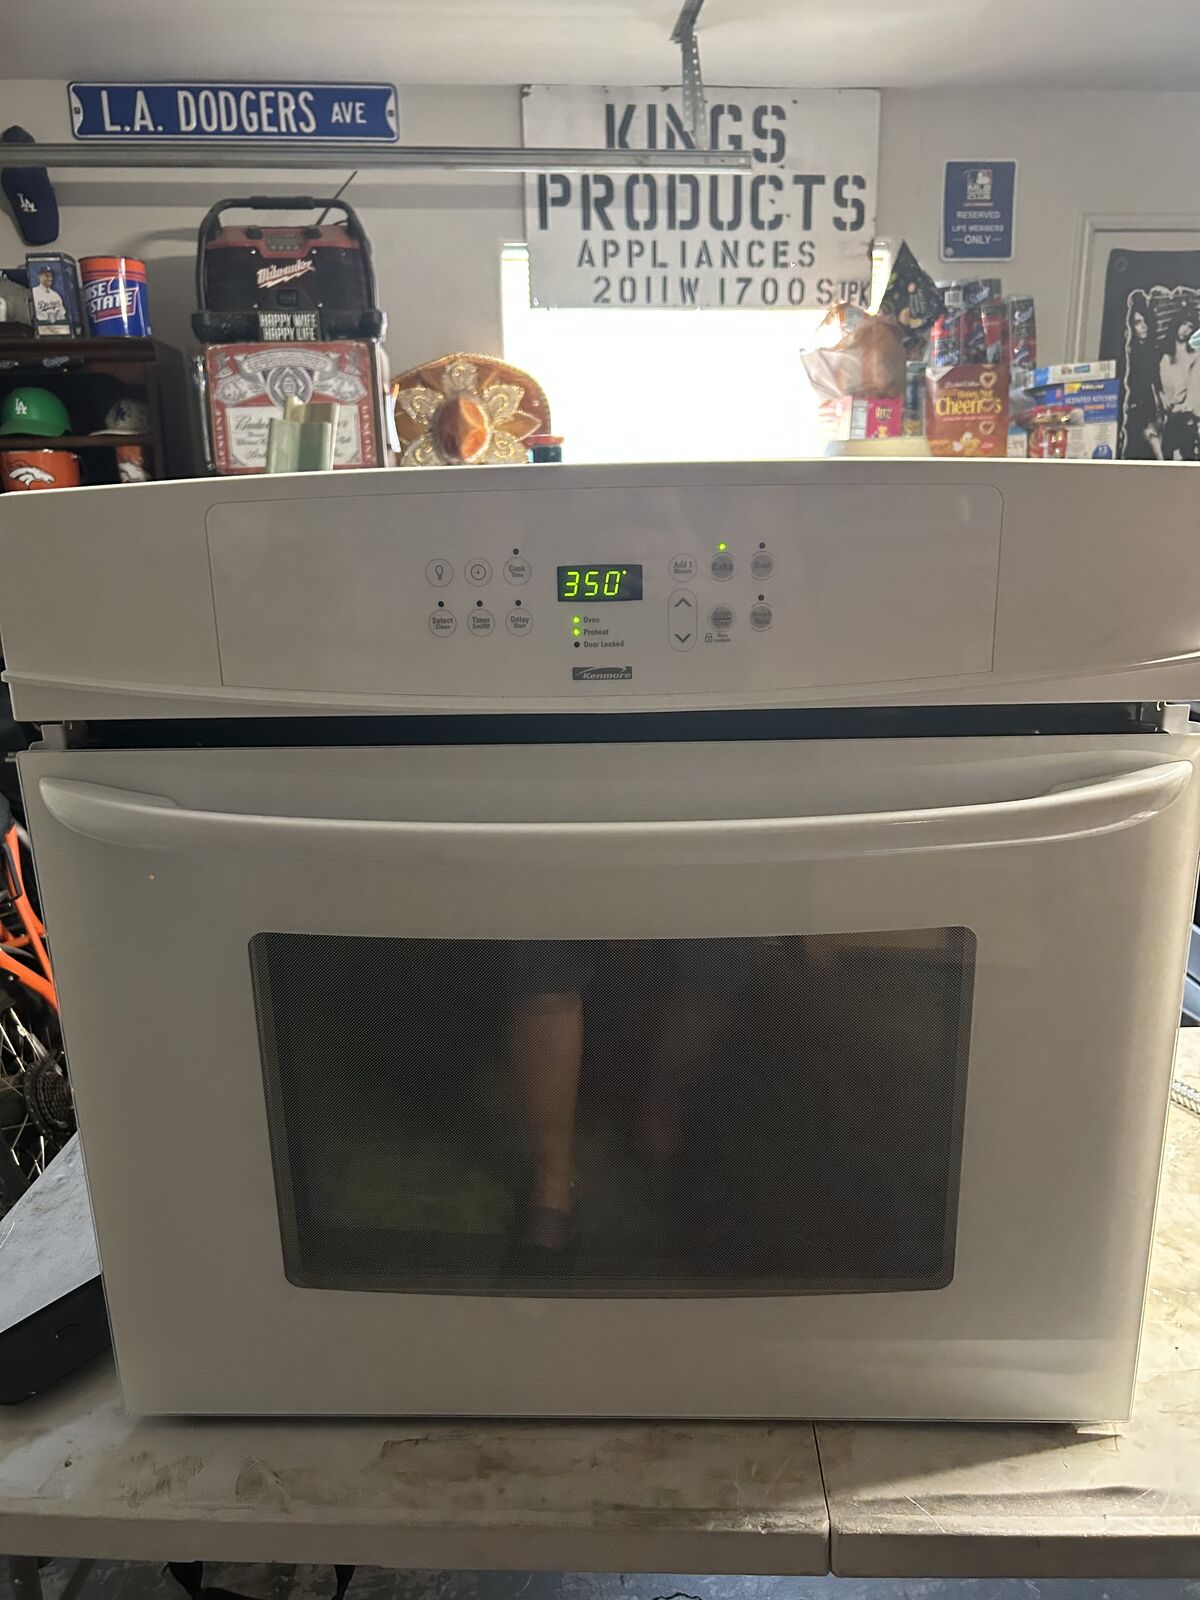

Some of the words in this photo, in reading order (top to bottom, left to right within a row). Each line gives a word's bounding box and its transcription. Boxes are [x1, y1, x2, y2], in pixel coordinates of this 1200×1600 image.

[101, 90, 163, 132] L.A.
[177, 91, 317, 133] DODGERS
[331, 102, 367, 124] AVE
[605, 103, 787, 164] KINGS
[537, 174, 867, 232] PRODUCTS
[956, 211, 1000, 219] RESERVED
[963, 235, 992, 244] ONLY
[577, 239, 816, 269] APPLIANCES
[259, 313, 292, 327] HAPPY
[293, 313, 317, 327] WIFE
[263, 327, 295, 341] HAPPY
[296, 327, 316, 341] LIFE
[14, 398, 28, 415] LA
[711, 562, 734, 571] Bake
[510, 615, 530, 623] Delay
[583, 616, 600, 624] Oven
[583, 628, 609, 636] Preheat
[601, 640, 624, 648] Locked
[582, 672, 632, 680] Kenmore
